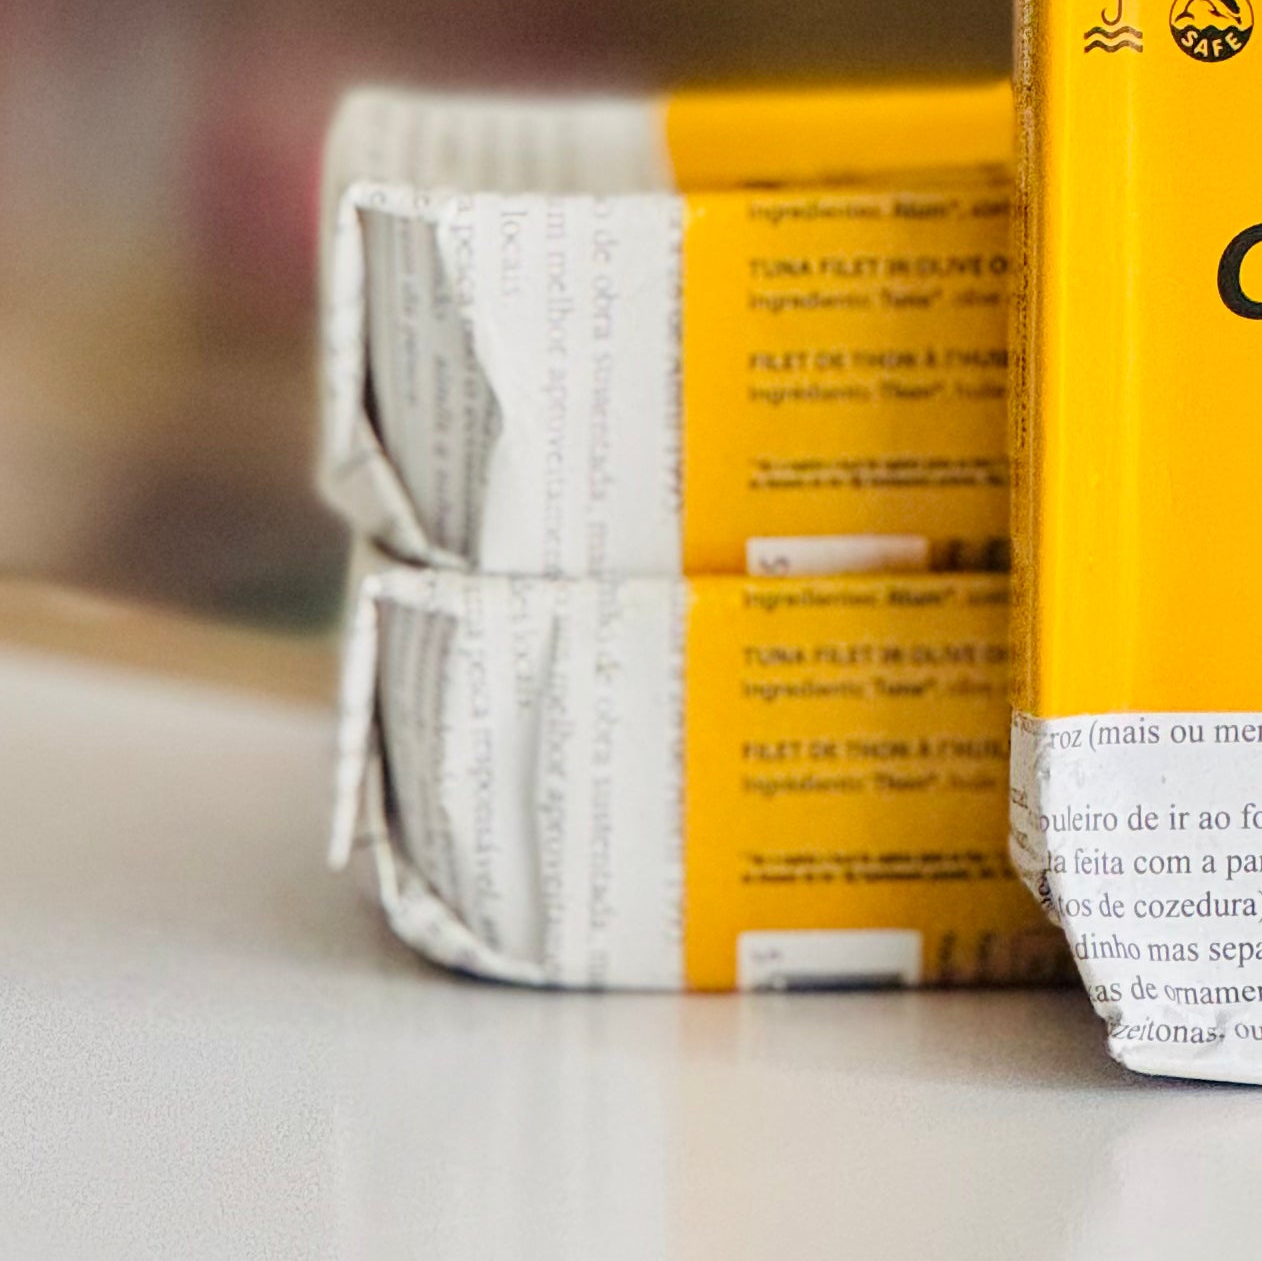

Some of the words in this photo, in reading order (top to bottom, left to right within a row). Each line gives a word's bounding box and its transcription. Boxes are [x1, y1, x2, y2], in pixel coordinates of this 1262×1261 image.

[1180, 29, 1243, 59] SAFE
[1088, 716, 1161, 752] (mais
[1169, 724, 1205, 745] ou
[1127, 803, 1160, 832] de
[1168, 803, 1191, 831] ir
[1198, 810, 1231, 831] ao
[1073, 847, 1125, 876] feita
[1133, 854, 1193, 876] com
[1201, 854, 1217, 874] a
[1098, 891, 1125, 919] de
[1074, 932, 1141, 961] dinho
[1147, 942, 1200, 963] mas
[1130, 974, 1159, 1001] de
